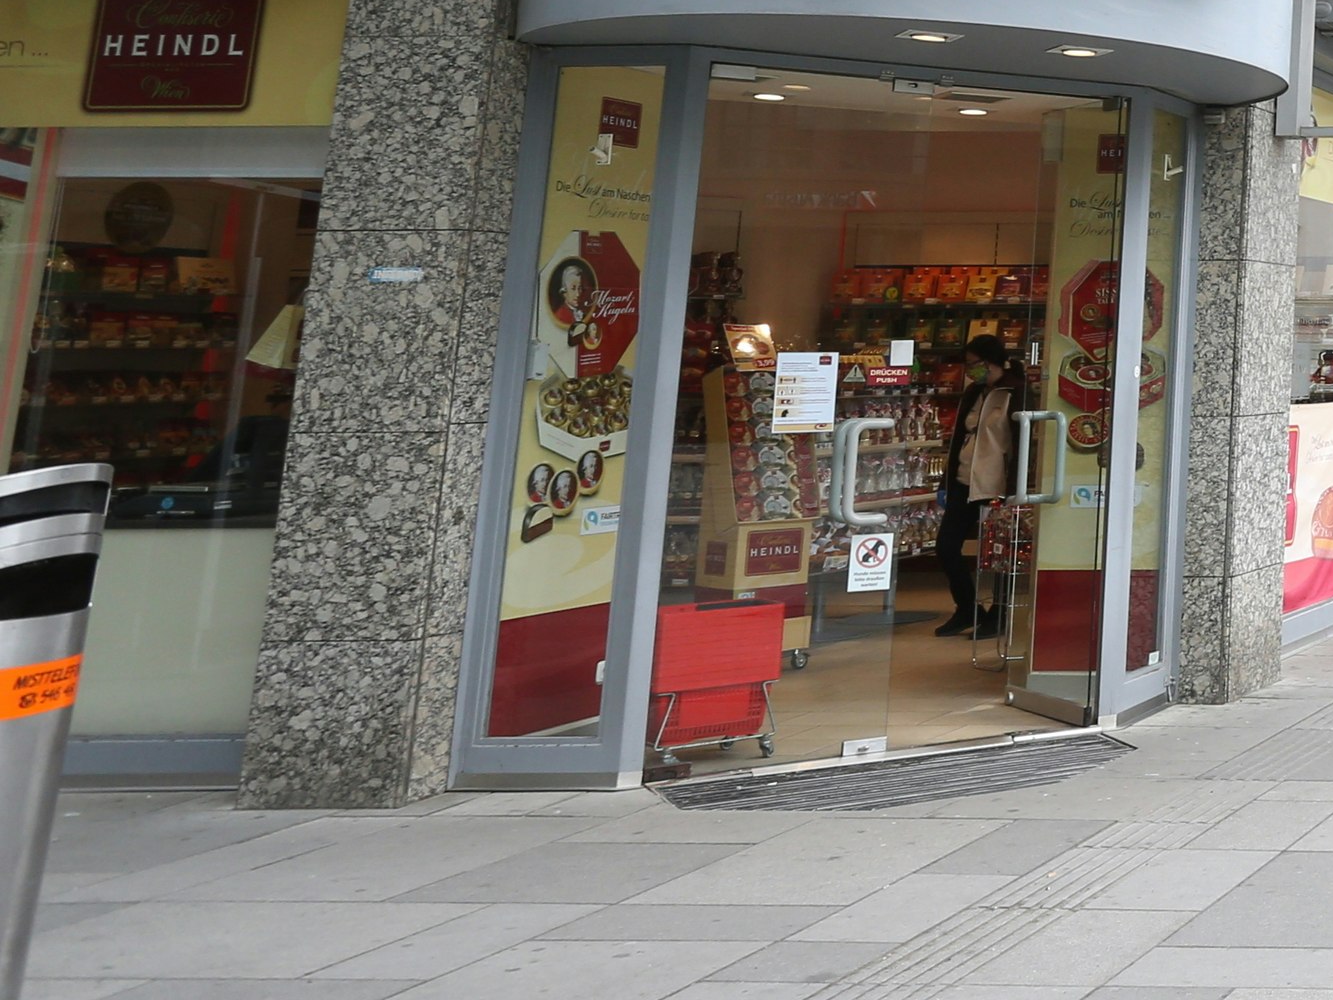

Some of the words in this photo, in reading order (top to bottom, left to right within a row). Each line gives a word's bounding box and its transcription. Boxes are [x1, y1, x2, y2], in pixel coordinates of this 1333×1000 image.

[103, 34, 244, 57] HEINDL
[141, 76, 191, 100] Wien
[602, 114, 638, 130] HEINDL
[556, 180, 571, 193] Die
[602, 189, 615, 198] am
[616, 188, 651, 202] Naschen
[1070, 198, 1087, 208] Die
[870, 367, 908, 376] DRÜCKEN
[751, 545, 799, 558] HEINDL
[13, 663, 80, 690] MISTTELEF
